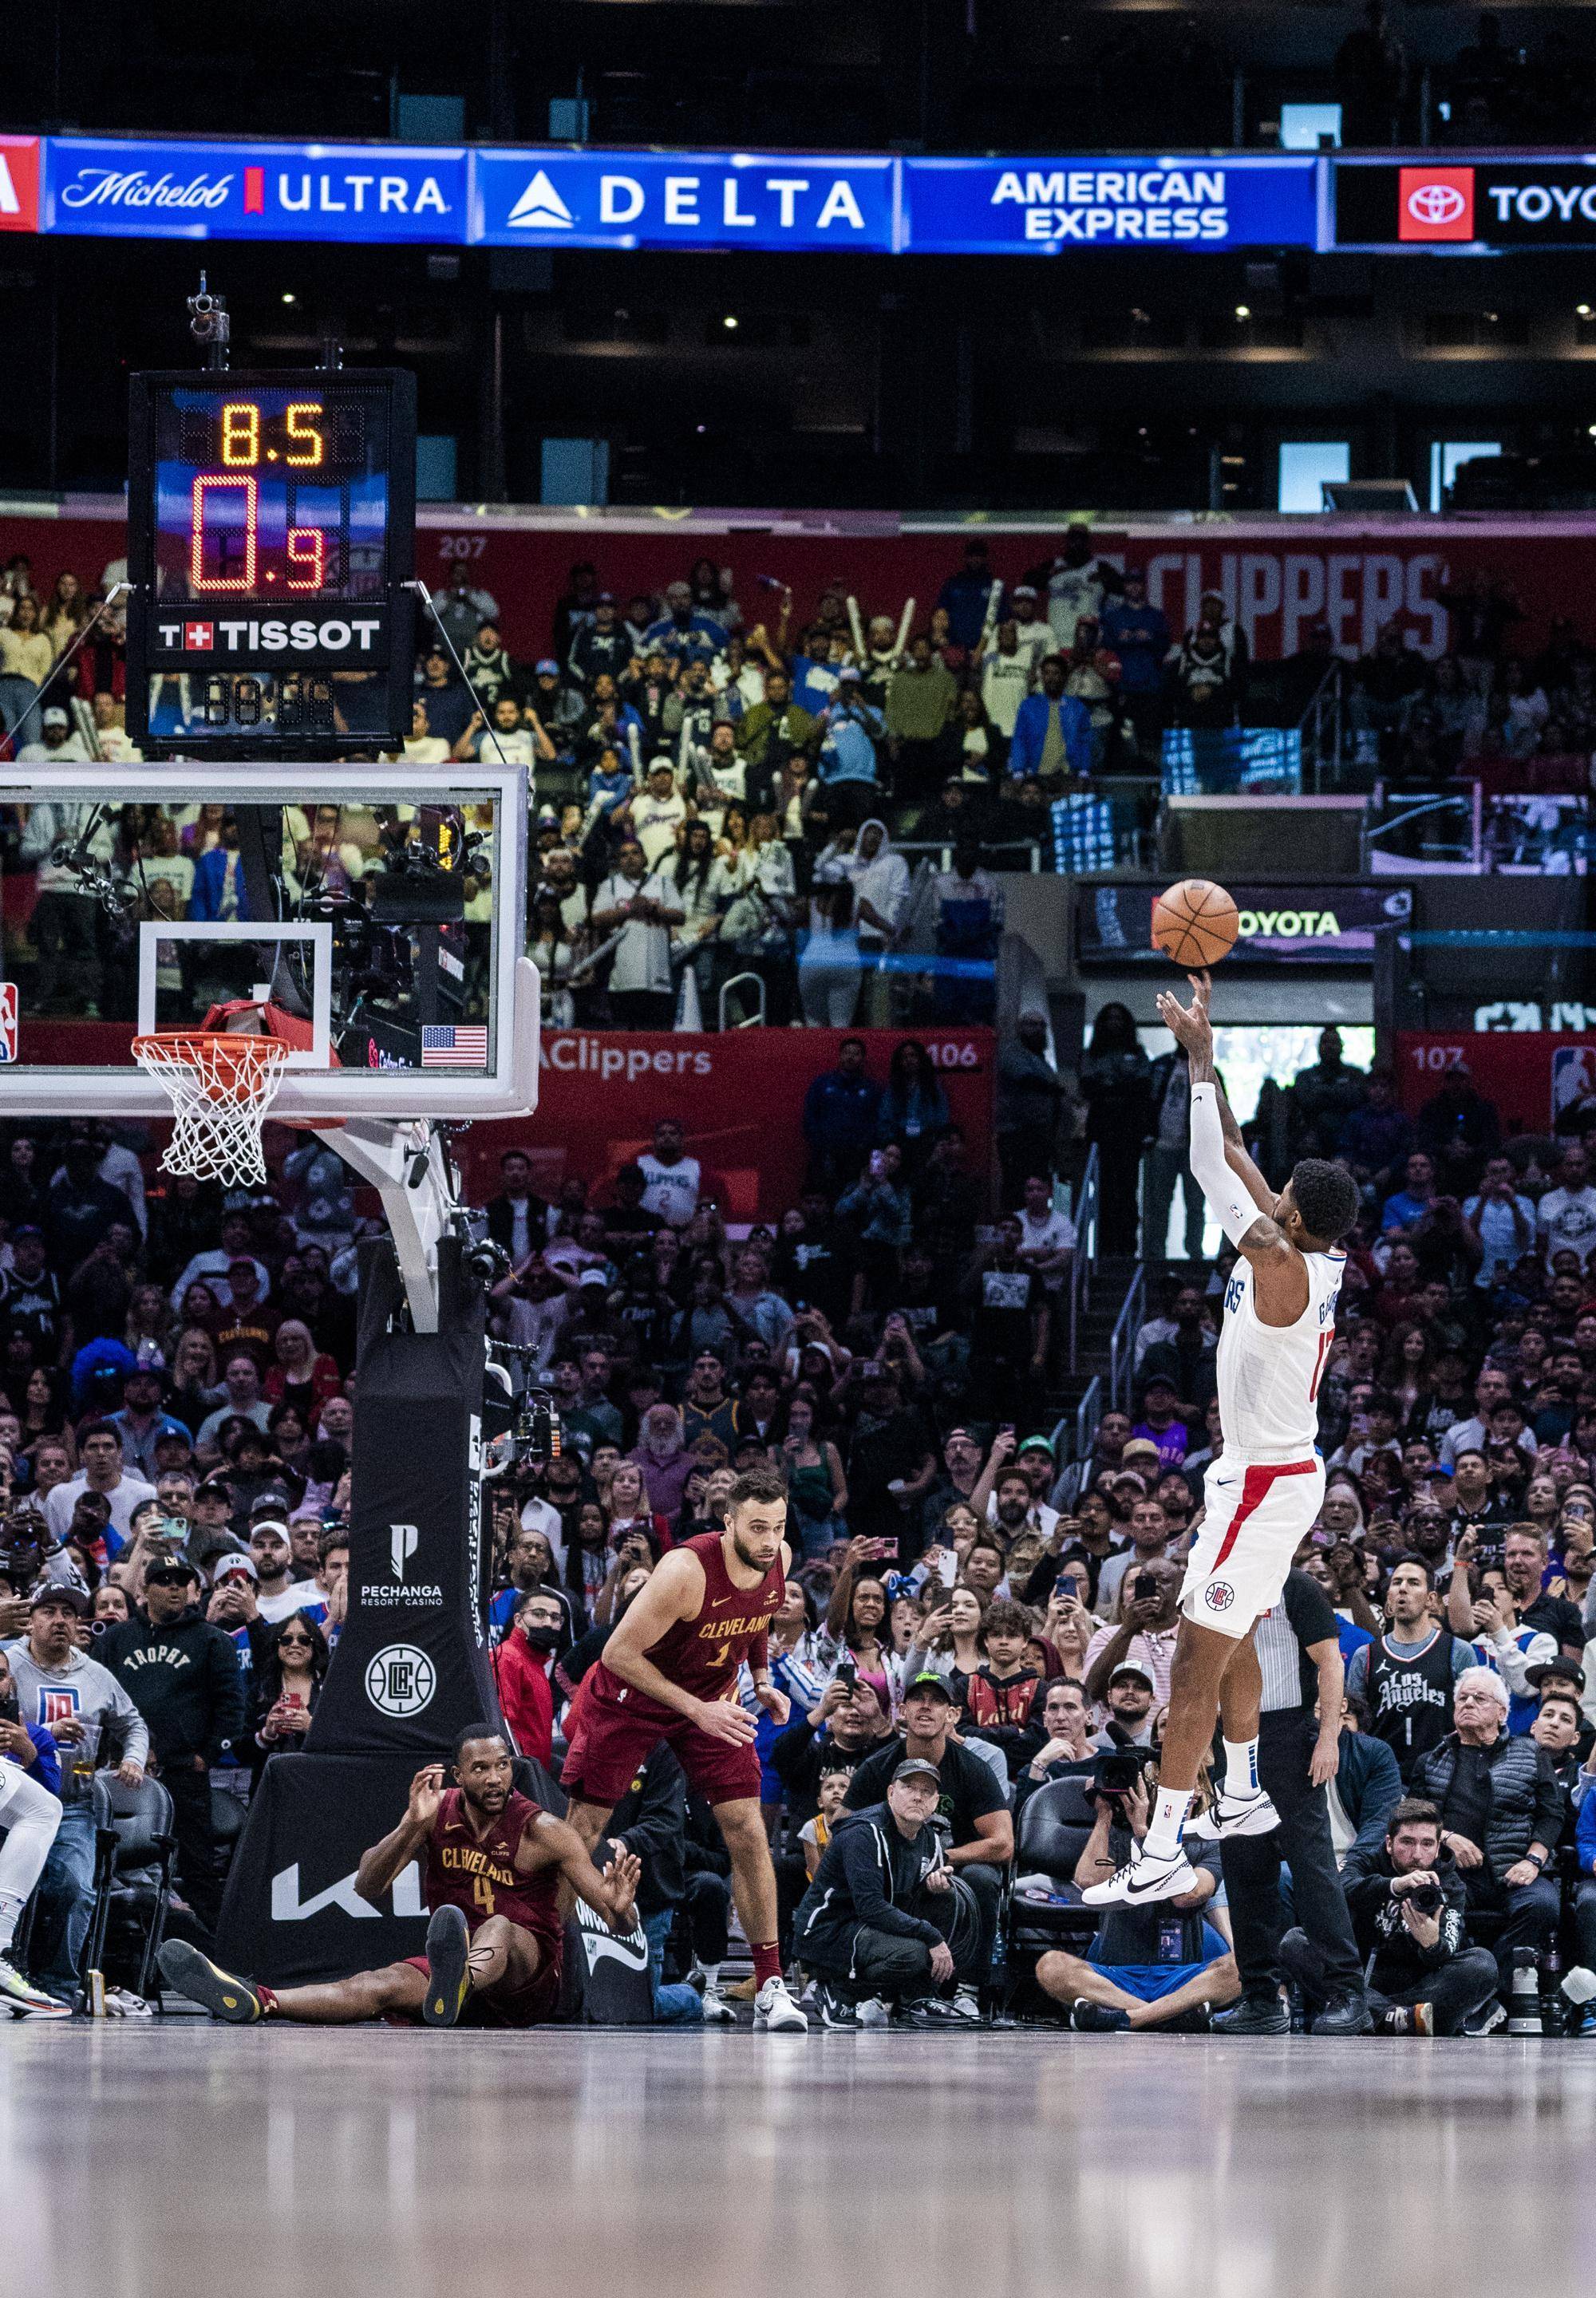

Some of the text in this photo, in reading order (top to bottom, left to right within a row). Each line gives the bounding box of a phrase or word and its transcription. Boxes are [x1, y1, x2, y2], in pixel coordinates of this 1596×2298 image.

[61, 168, 447, 214] Michelob ULTRA
[599, 175, 866, 229] DELTA
[991, 172, 1226, 204] AMERICAN
[1488, 186, 1596, 222] TOYO
[1025, 207, 1229, 239] EXPRESS
[222, 403, 323, 466] 8.5
[192, 475, 323, 590] 0.9
[439, 536, 487, 559] 207
[219, 620, 380, 650] TISSOT
[1237, 910, 1341, 938] OYOTA
[929, 1042, 978, 1068] 106
[1412, 1046, 1464, 1071] 107
[361, 1585, 443, 1597] PECHANGA
[698, 1613, 772, 1639] CLEVELAND
[122, 1645, 192, 1672] TROPHY
[705, 1641, 732, 1668] 1
[1389, 1670, 1422, 1690] Los
[1376, 1679, 1446, 1718] Angeles
[473, 1875, 496, 1914] 4
